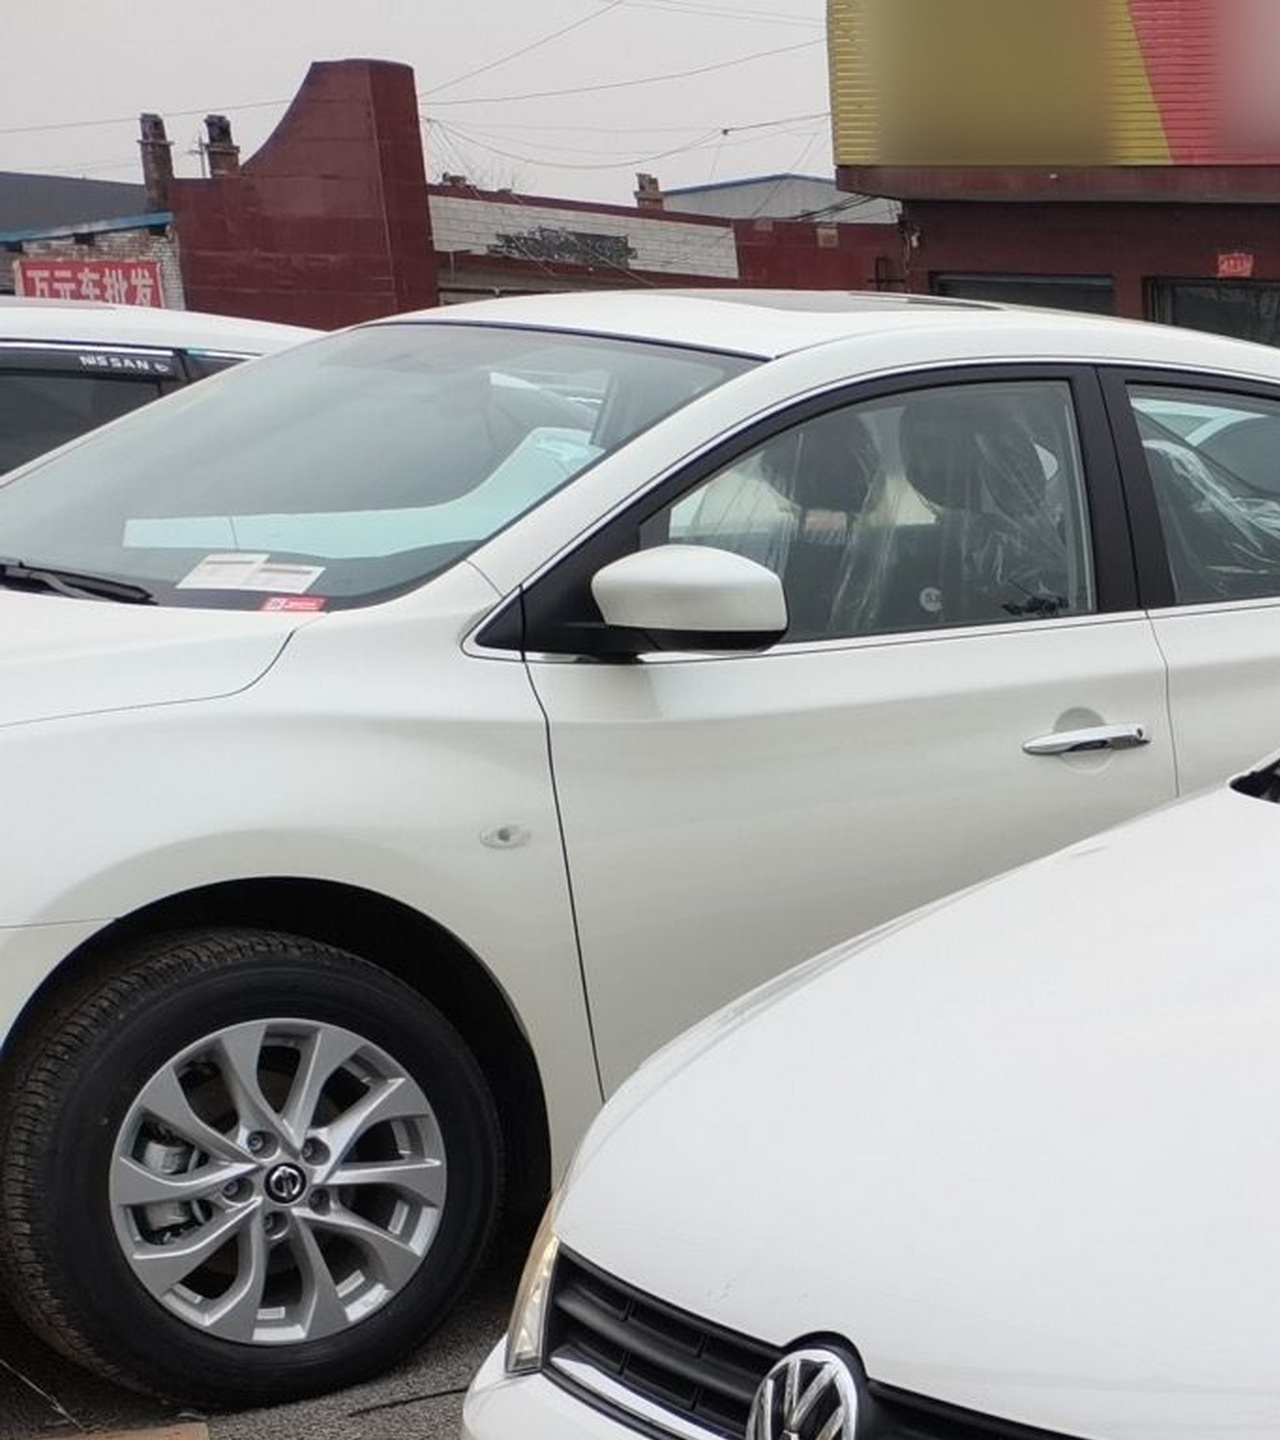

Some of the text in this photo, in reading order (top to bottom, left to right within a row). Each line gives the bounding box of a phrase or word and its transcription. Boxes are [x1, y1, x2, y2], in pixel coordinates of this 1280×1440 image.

[26, 267, 154, 305] 万元车批发
[79, 355, 149, 370] NISSAN
